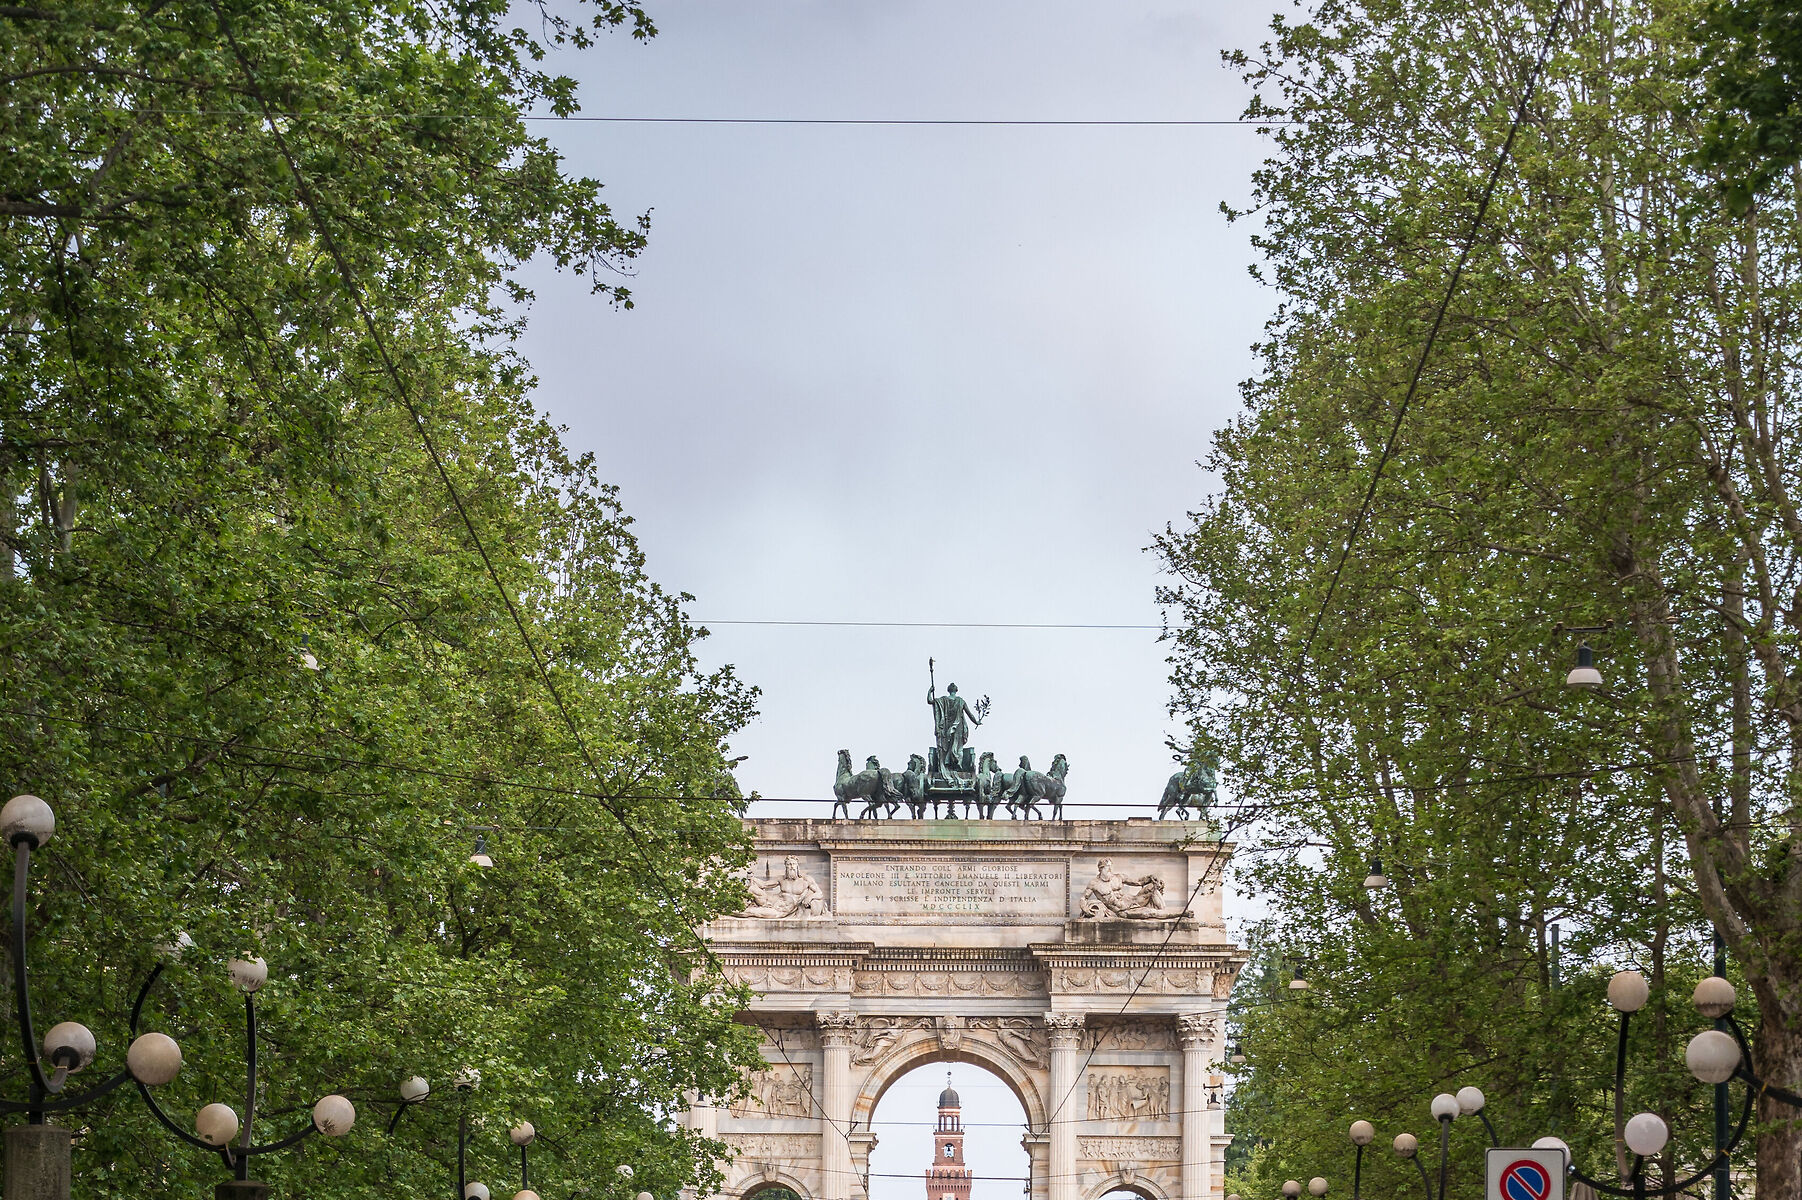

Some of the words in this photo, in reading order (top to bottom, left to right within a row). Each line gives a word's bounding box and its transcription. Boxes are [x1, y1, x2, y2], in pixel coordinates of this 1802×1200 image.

[891, 872, 899, 880] III
[934, 880, 973, 888] CANCELLO
[890, 895, 919, 903] SCRISSE
